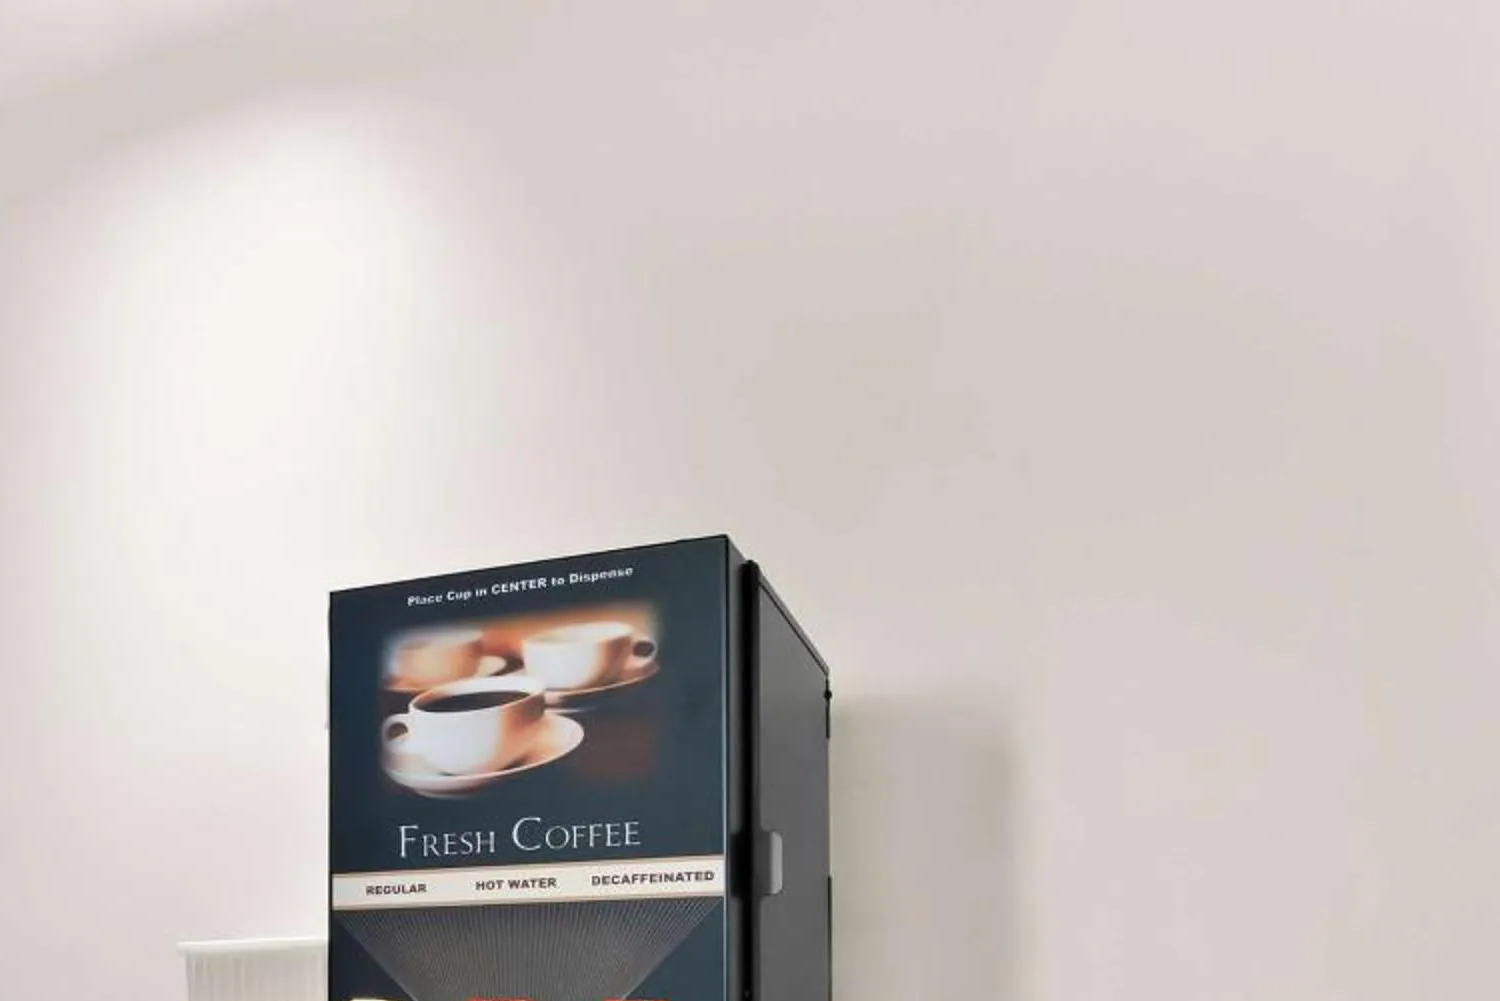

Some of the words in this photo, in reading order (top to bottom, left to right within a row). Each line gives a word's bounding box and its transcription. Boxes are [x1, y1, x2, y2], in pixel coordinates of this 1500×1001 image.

[407, 594, 443, 607] Place
[446, 590, 472, 601] Cup
[475, 587, 488, 598] in
[491, 576, 548, 596] CENTER
[551, 576, 566, 587] to
[568, 566, 634, 585] Dispense
[474, 878, 504, 891] HOT
[507, 877, 558, 890] WATER
[590, 869, 716, 887] DECAFFEINATED
[365, 883, 428, 896] REGULAR
